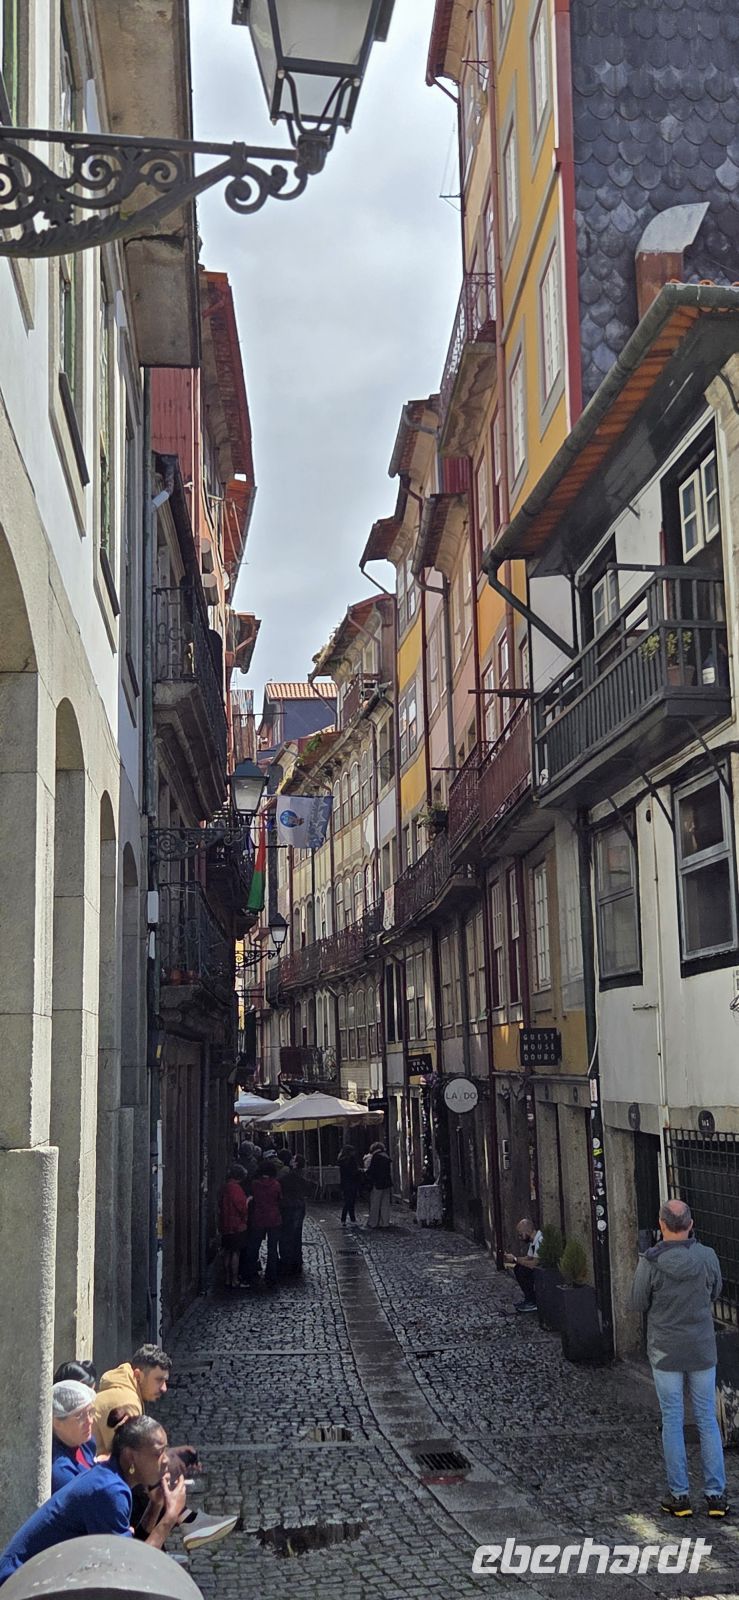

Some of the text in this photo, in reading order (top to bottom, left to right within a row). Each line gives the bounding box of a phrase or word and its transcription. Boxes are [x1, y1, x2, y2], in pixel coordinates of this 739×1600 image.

[523, 1033, 555, 1041] GUEST
[523, 1043, 555, 1051] HOUSE
[523, 1053, 556, 1061] DOURO
